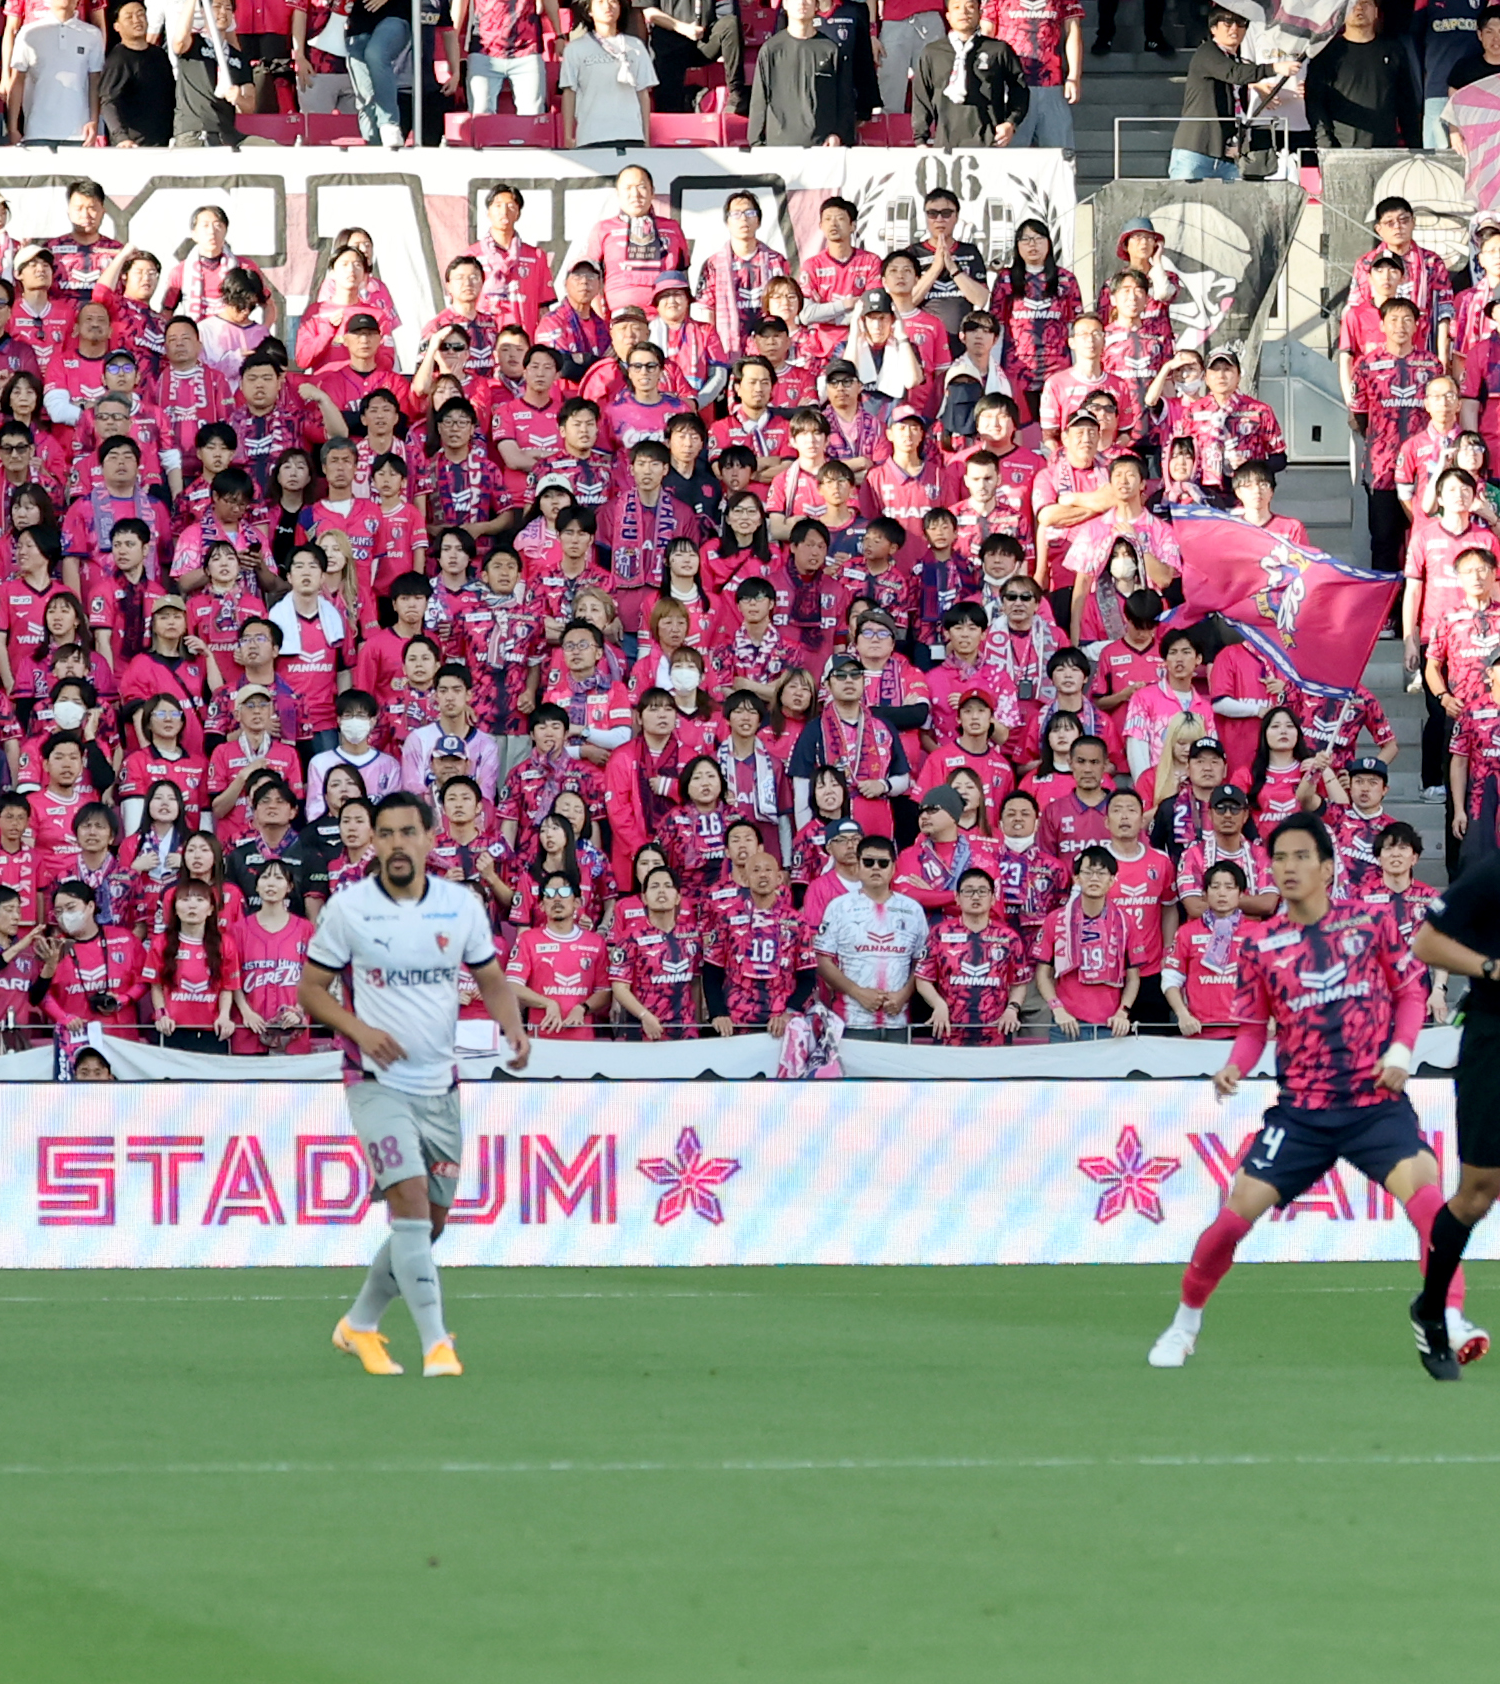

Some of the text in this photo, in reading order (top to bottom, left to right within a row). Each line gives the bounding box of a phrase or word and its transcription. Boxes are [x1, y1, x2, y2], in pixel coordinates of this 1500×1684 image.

[1433, 18, 1477, 31] CAPCO
[699, 815, 722, 835] 16
[751, 939, 774, 962] 16
[853, 943, 908, 955] YANMAR
[1082, 948, 1104, 970] 19
[1286, 981, 1372, 1011] YANMAR
[1251, 1125, 1287, 1161] 4
